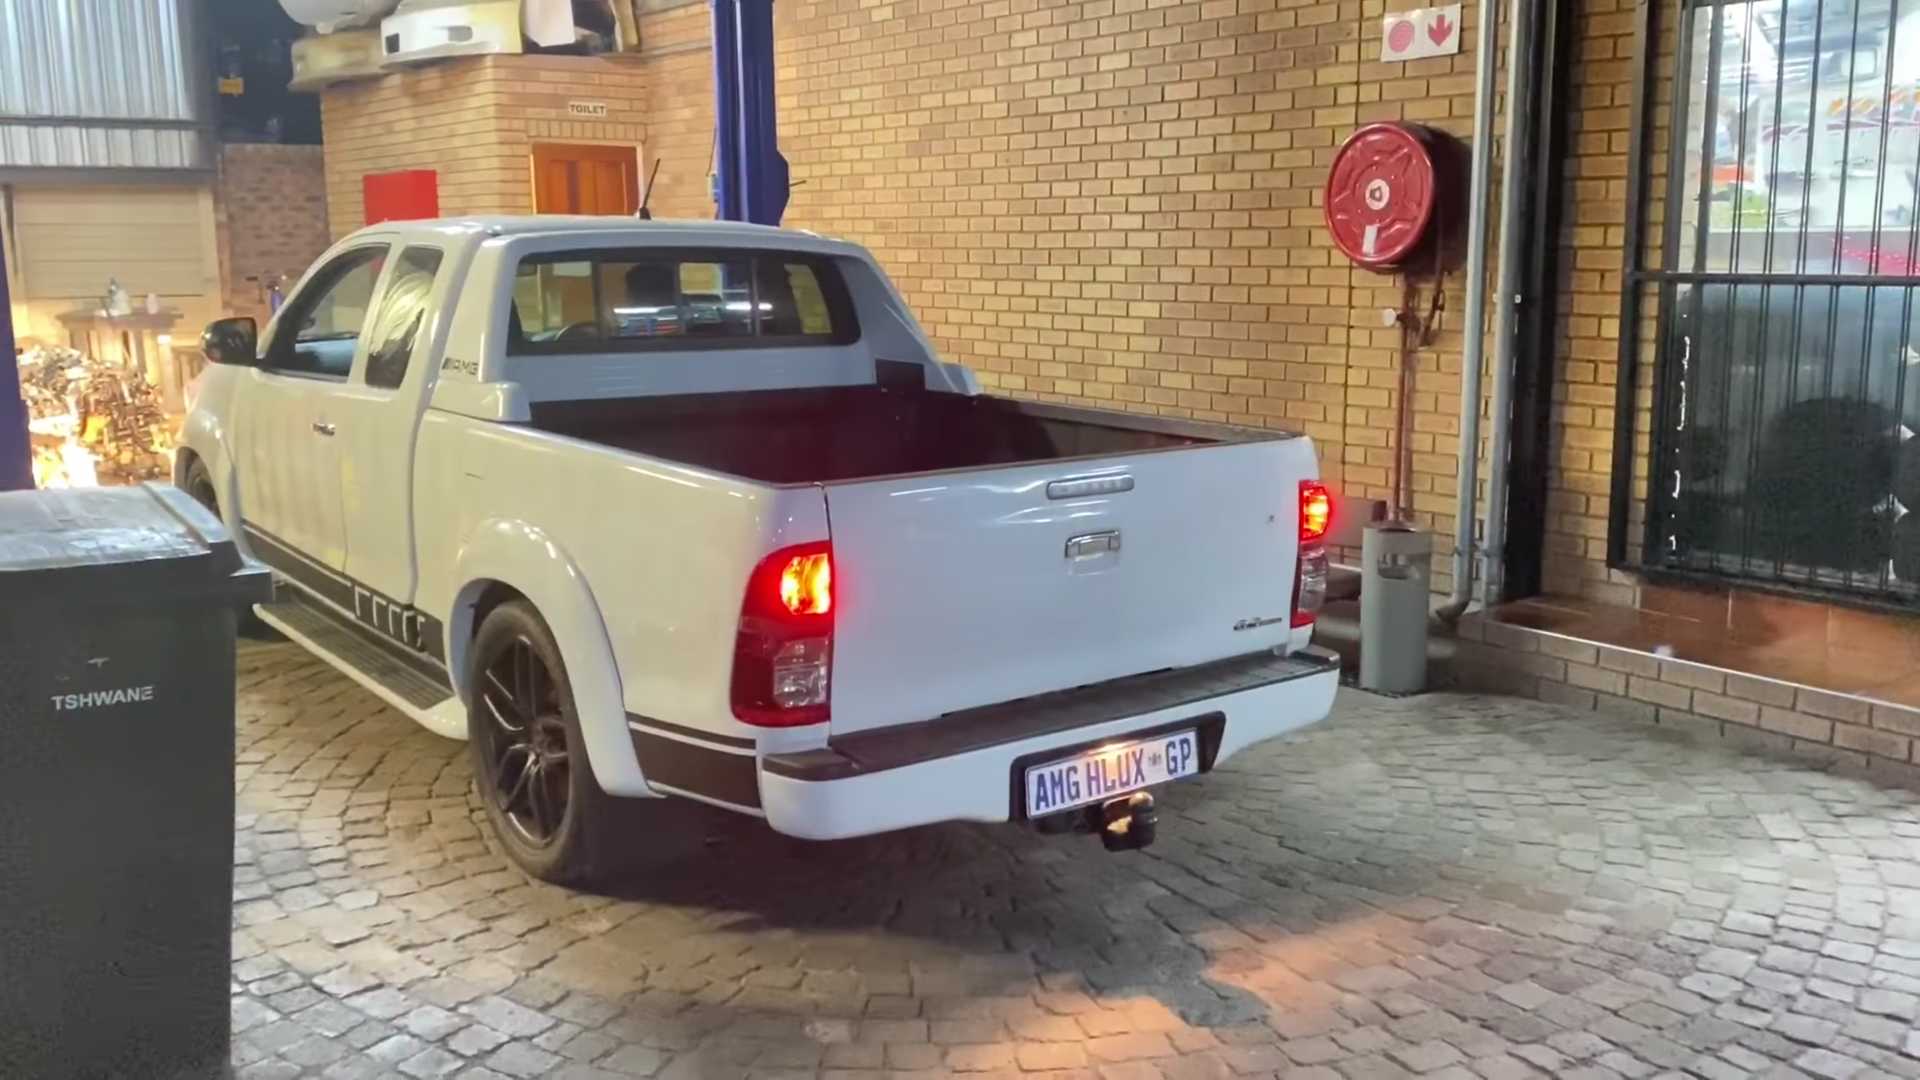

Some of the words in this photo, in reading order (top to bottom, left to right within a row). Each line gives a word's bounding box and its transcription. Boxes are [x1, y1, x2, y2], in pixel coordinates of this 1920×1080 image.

[569, 103, 605, 115] TOILET
[51, 686, 154, 711] TSHWANE
[1035, 765, 1081, 811] AMG
[1086, 748, 1145, 797] HLUX
[1165, 737, 1192, 776] GP
